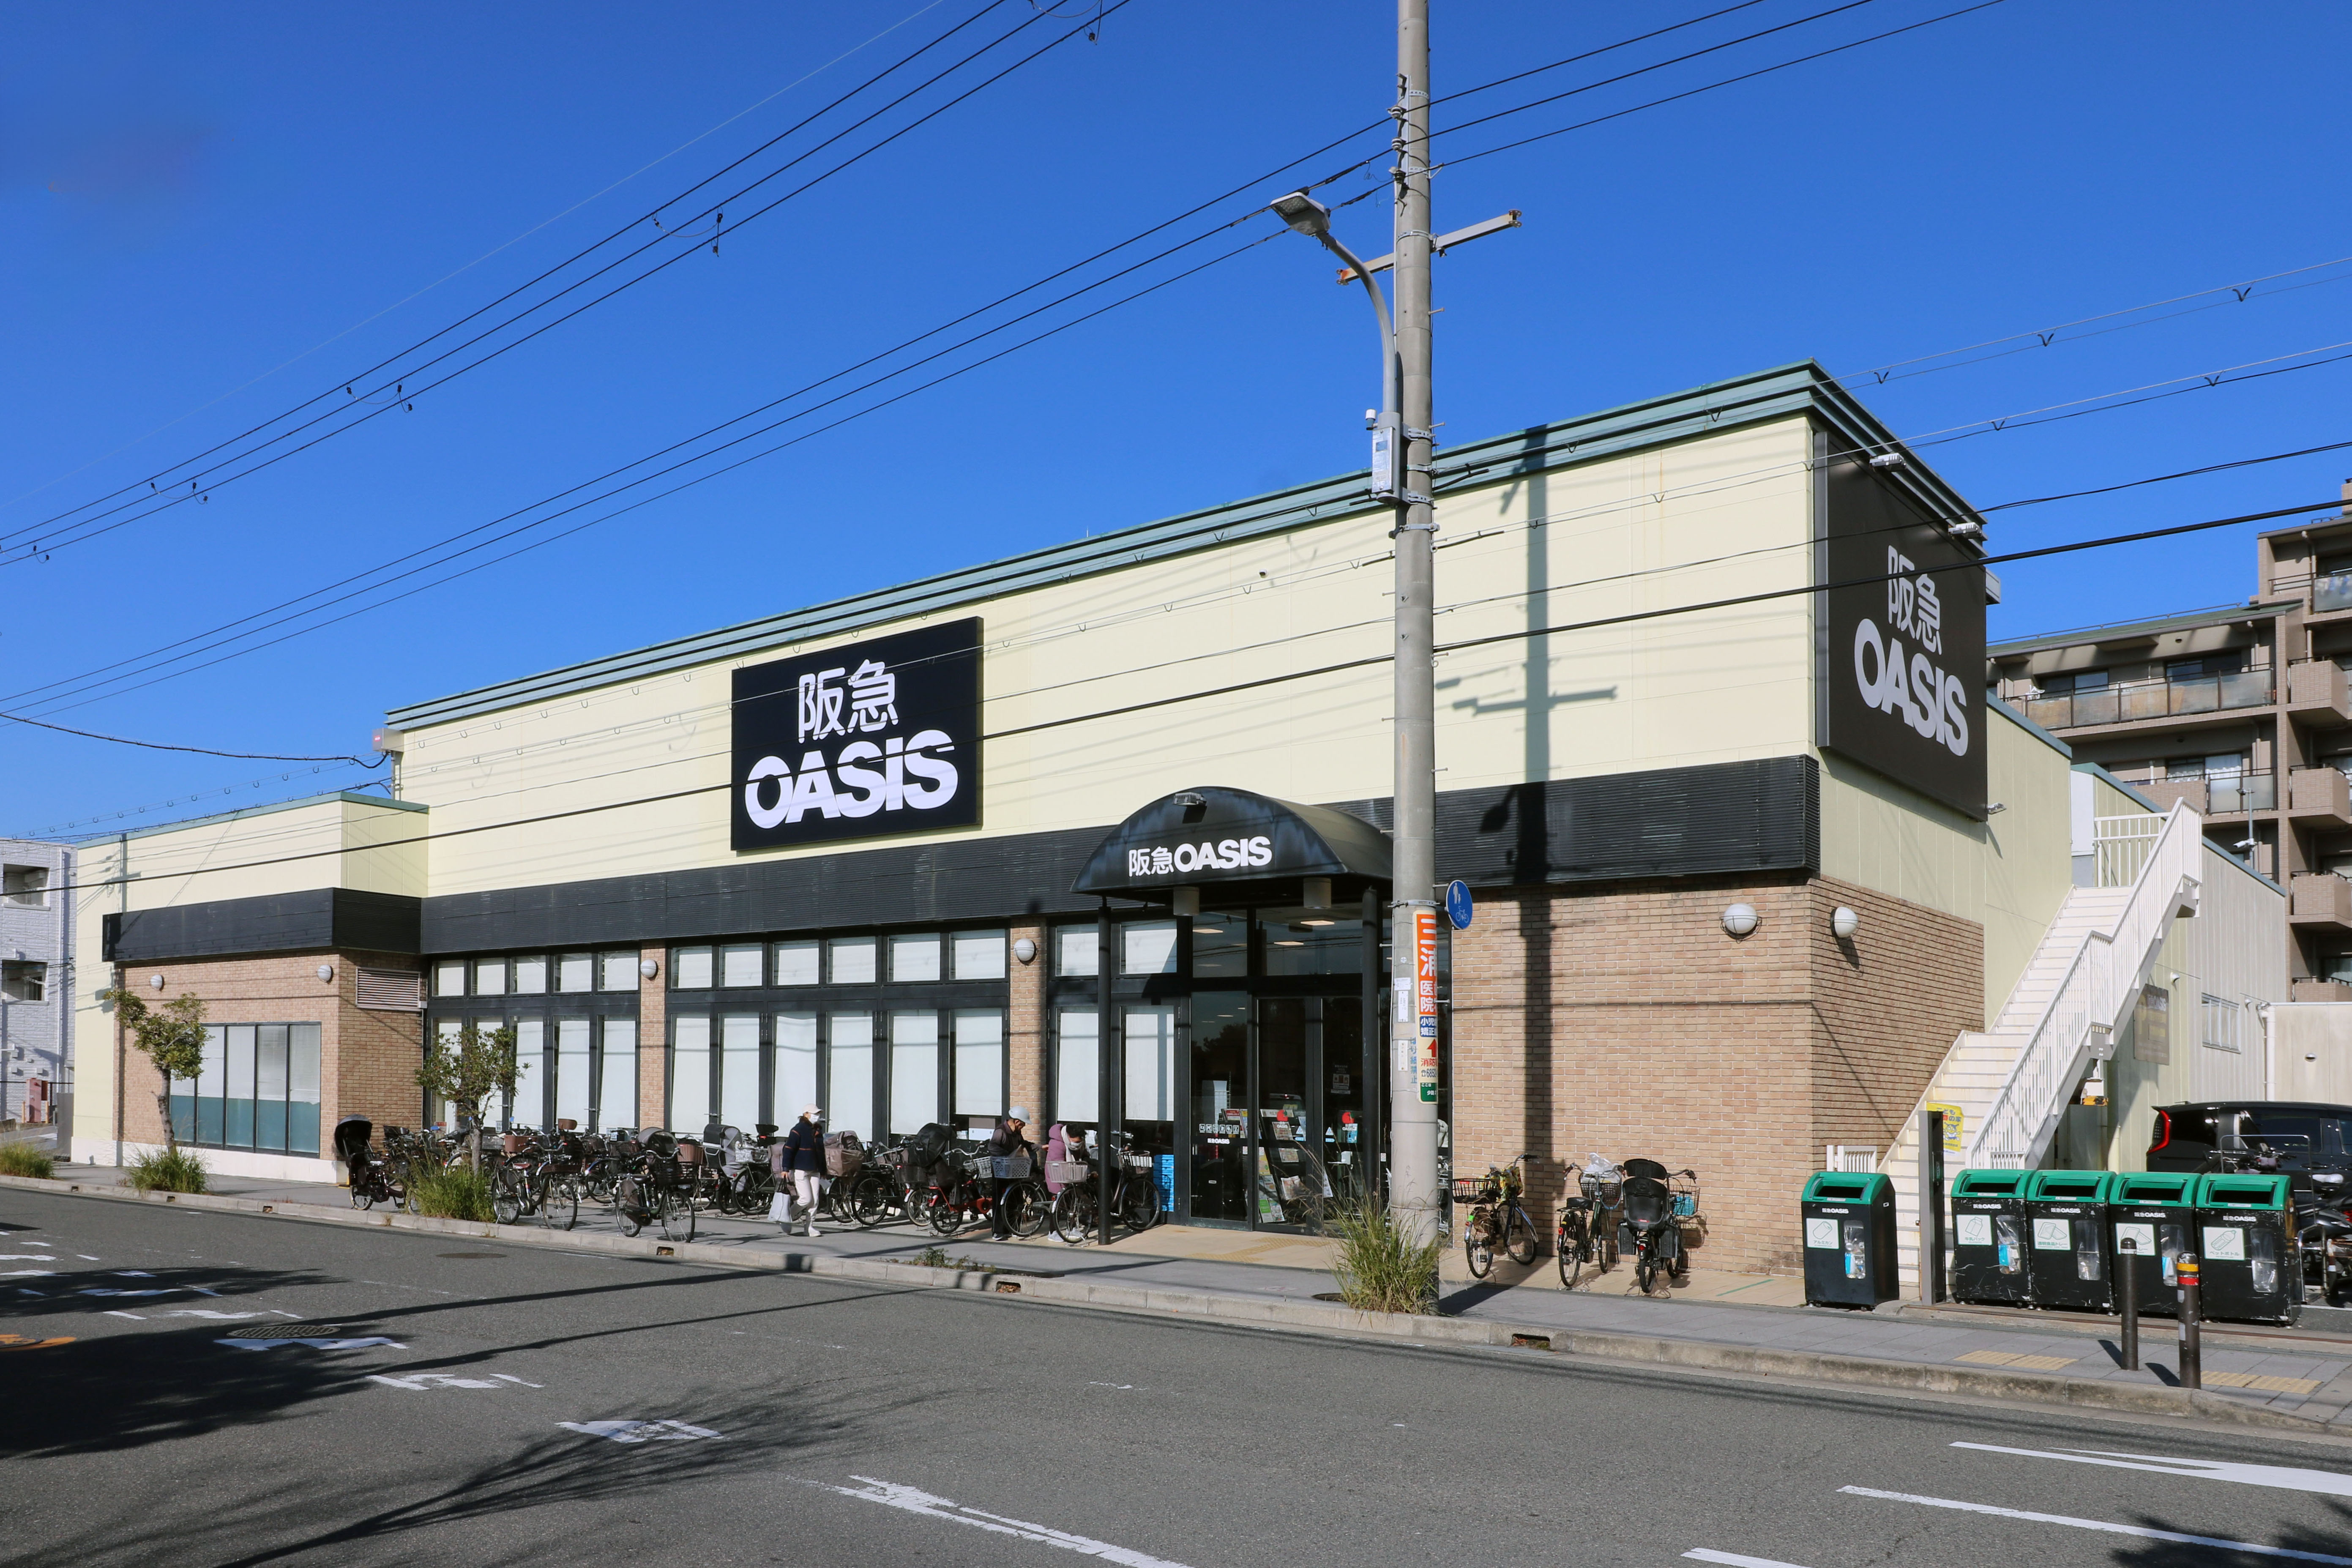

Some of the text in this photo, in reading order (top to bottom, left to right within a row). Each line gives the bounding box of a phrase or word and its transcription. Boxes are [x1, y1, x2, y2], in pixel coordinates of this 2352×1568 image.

[1888, 545, 1942, 655] 阪急
[798, 658, 899, 744] 阪急
[1854, 618, 1969, 757] OASIS
[745, 729, 958, 829] OASIS
[1128, 836, 1273, 877] 阪急OASIS
[1420, 1017, 1436, 1026] 小児
[1420, 1027, 1436, 1035] 矯正
[1421, 1058, 1437, 1067] 消防
